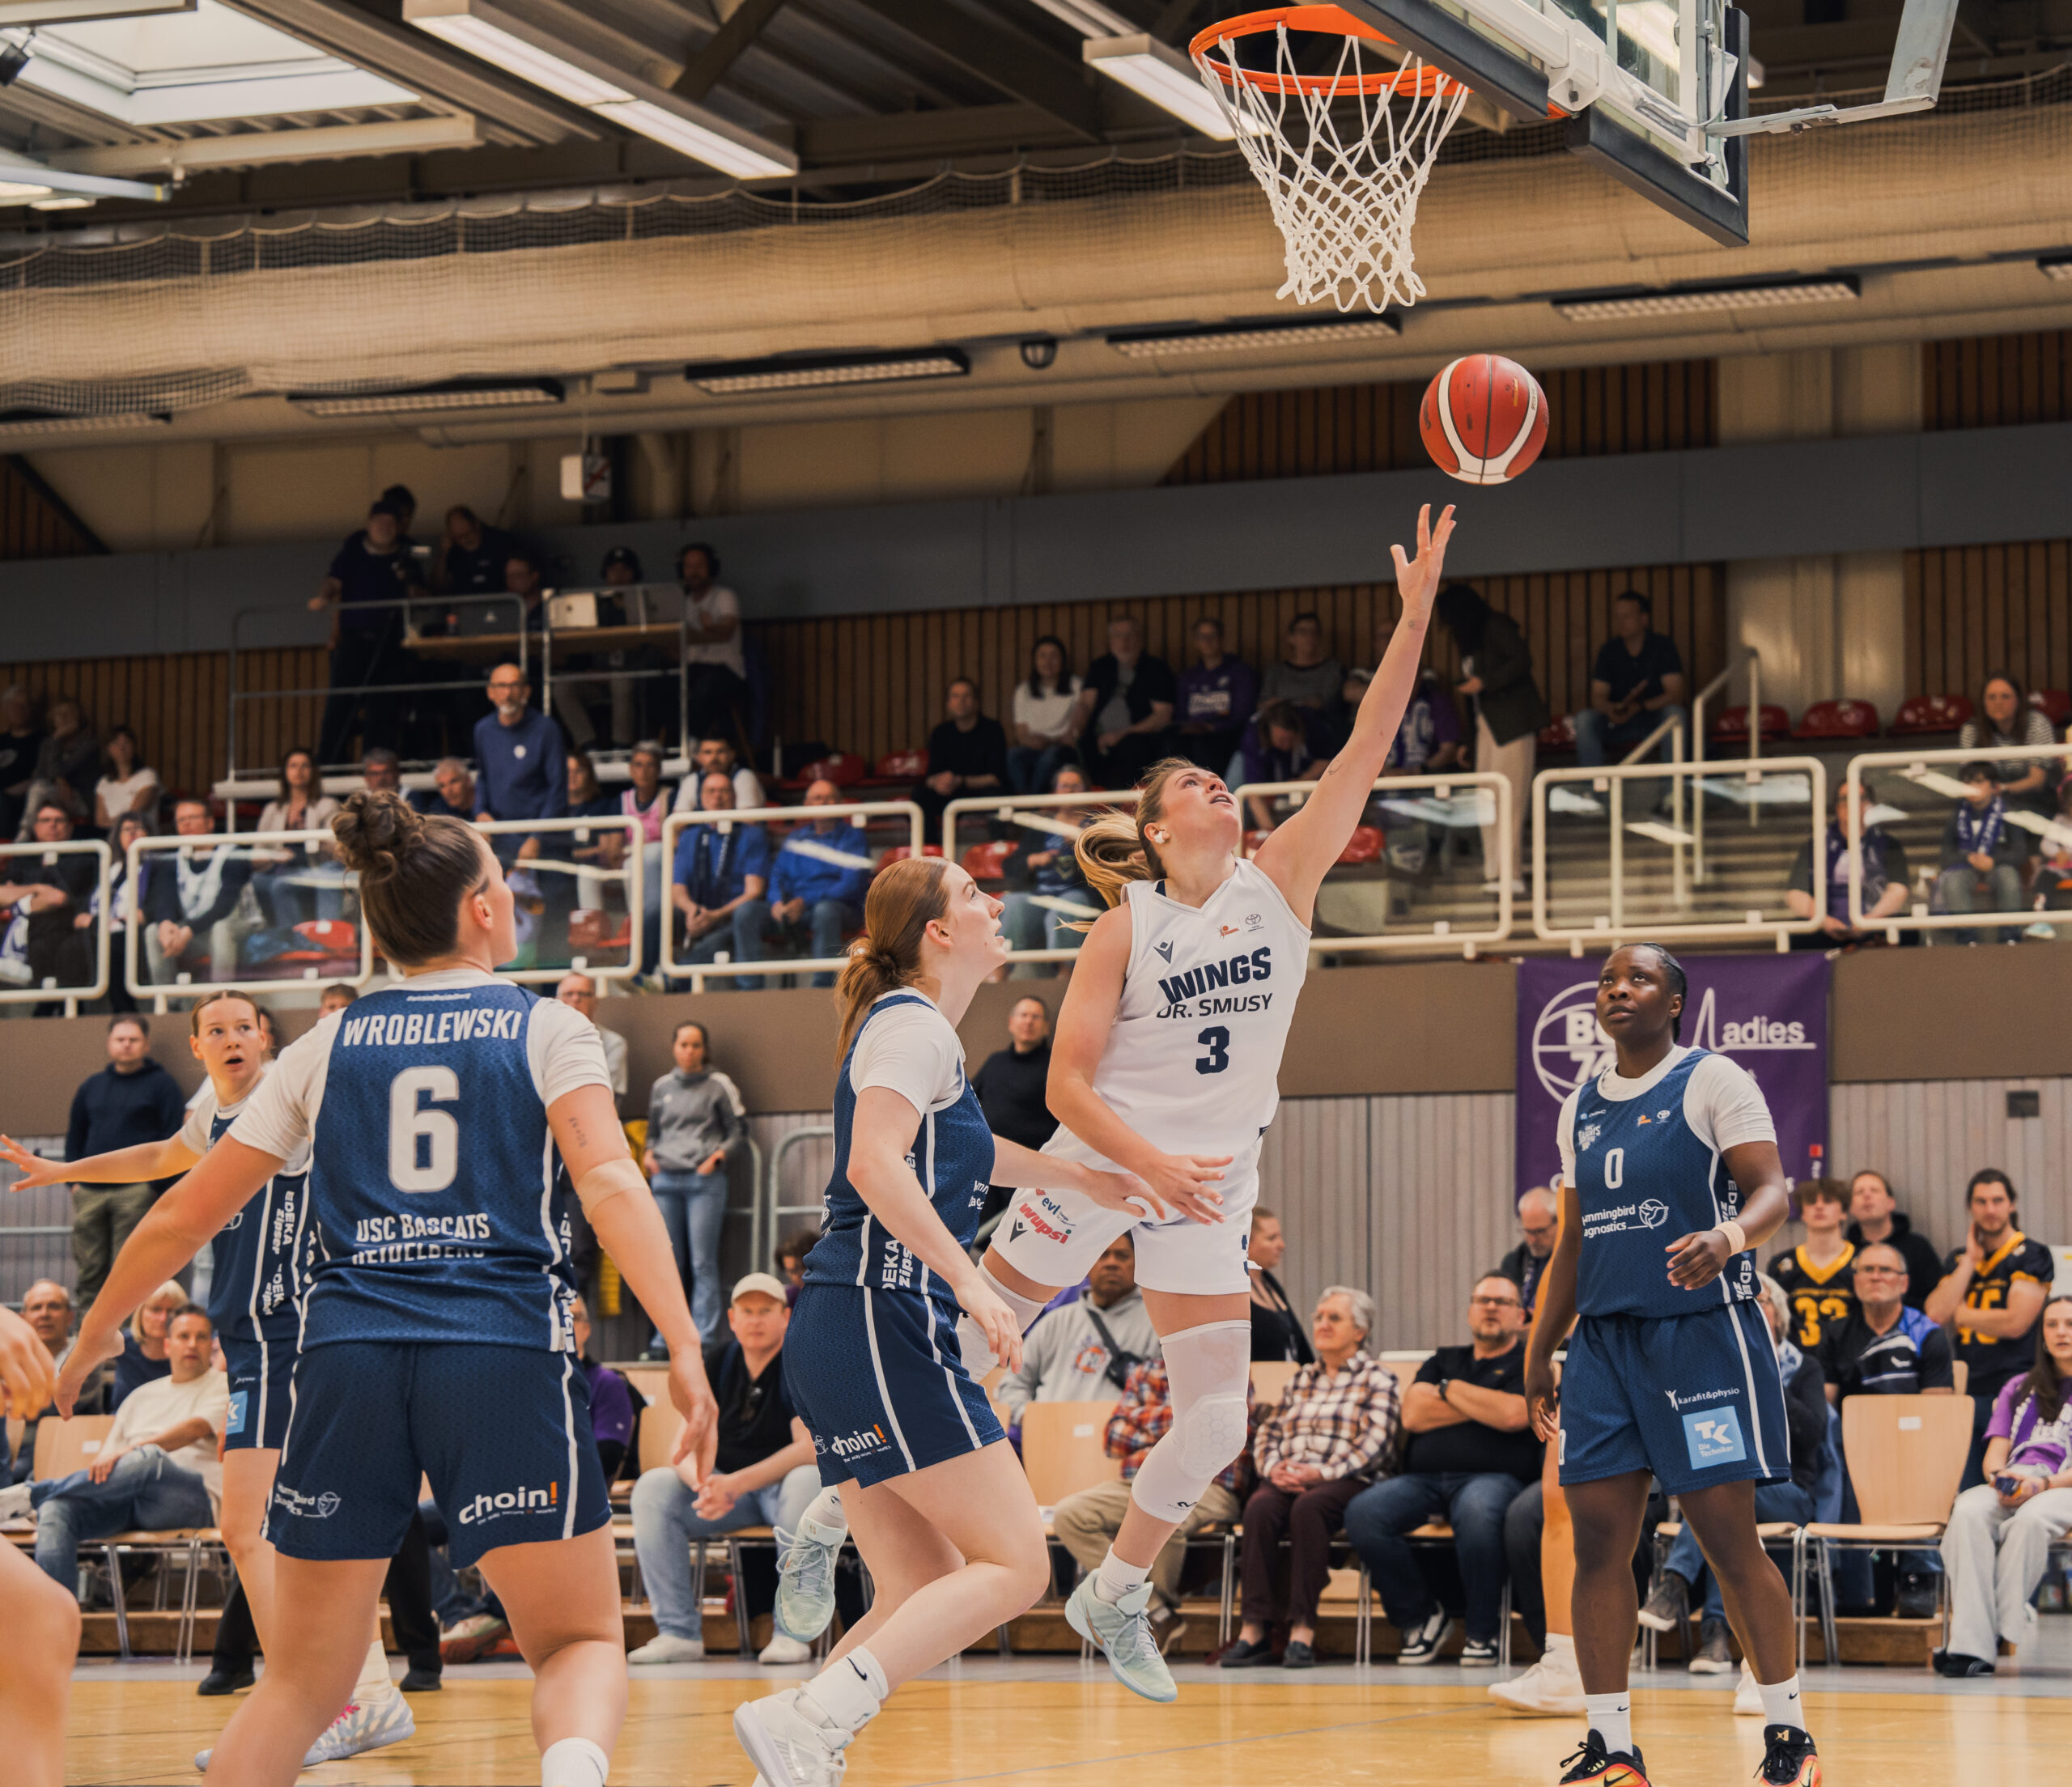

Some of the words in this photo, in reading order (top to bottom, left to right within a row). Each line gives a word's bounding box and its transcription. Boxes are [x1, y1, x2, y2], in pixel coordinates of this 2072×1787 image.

[1157, 946, 1272, 1005] WINGS
[1199, 993, 1273, 1017] SMUSY
[343, 1008, 523, 1046] WROBLEWSKI
[1195, 1025, 1229, 1075] 3
[388, 1065, 460, 1193] 6
[1604, 1148, 1624, 1189] 0
[282, 1191, 295, 1246] EDEKA
[1019, 1203, 1072, 1245] wupsi
[1042, 1197, 1061, 1215] evl
[356, 1216, 396, 1242] USC
[1678, 1388, 1740, 1404] karafit&physio
[1694, 1420, 1733, 1445] TK
[458, 1481, 558, 1525] choin!
